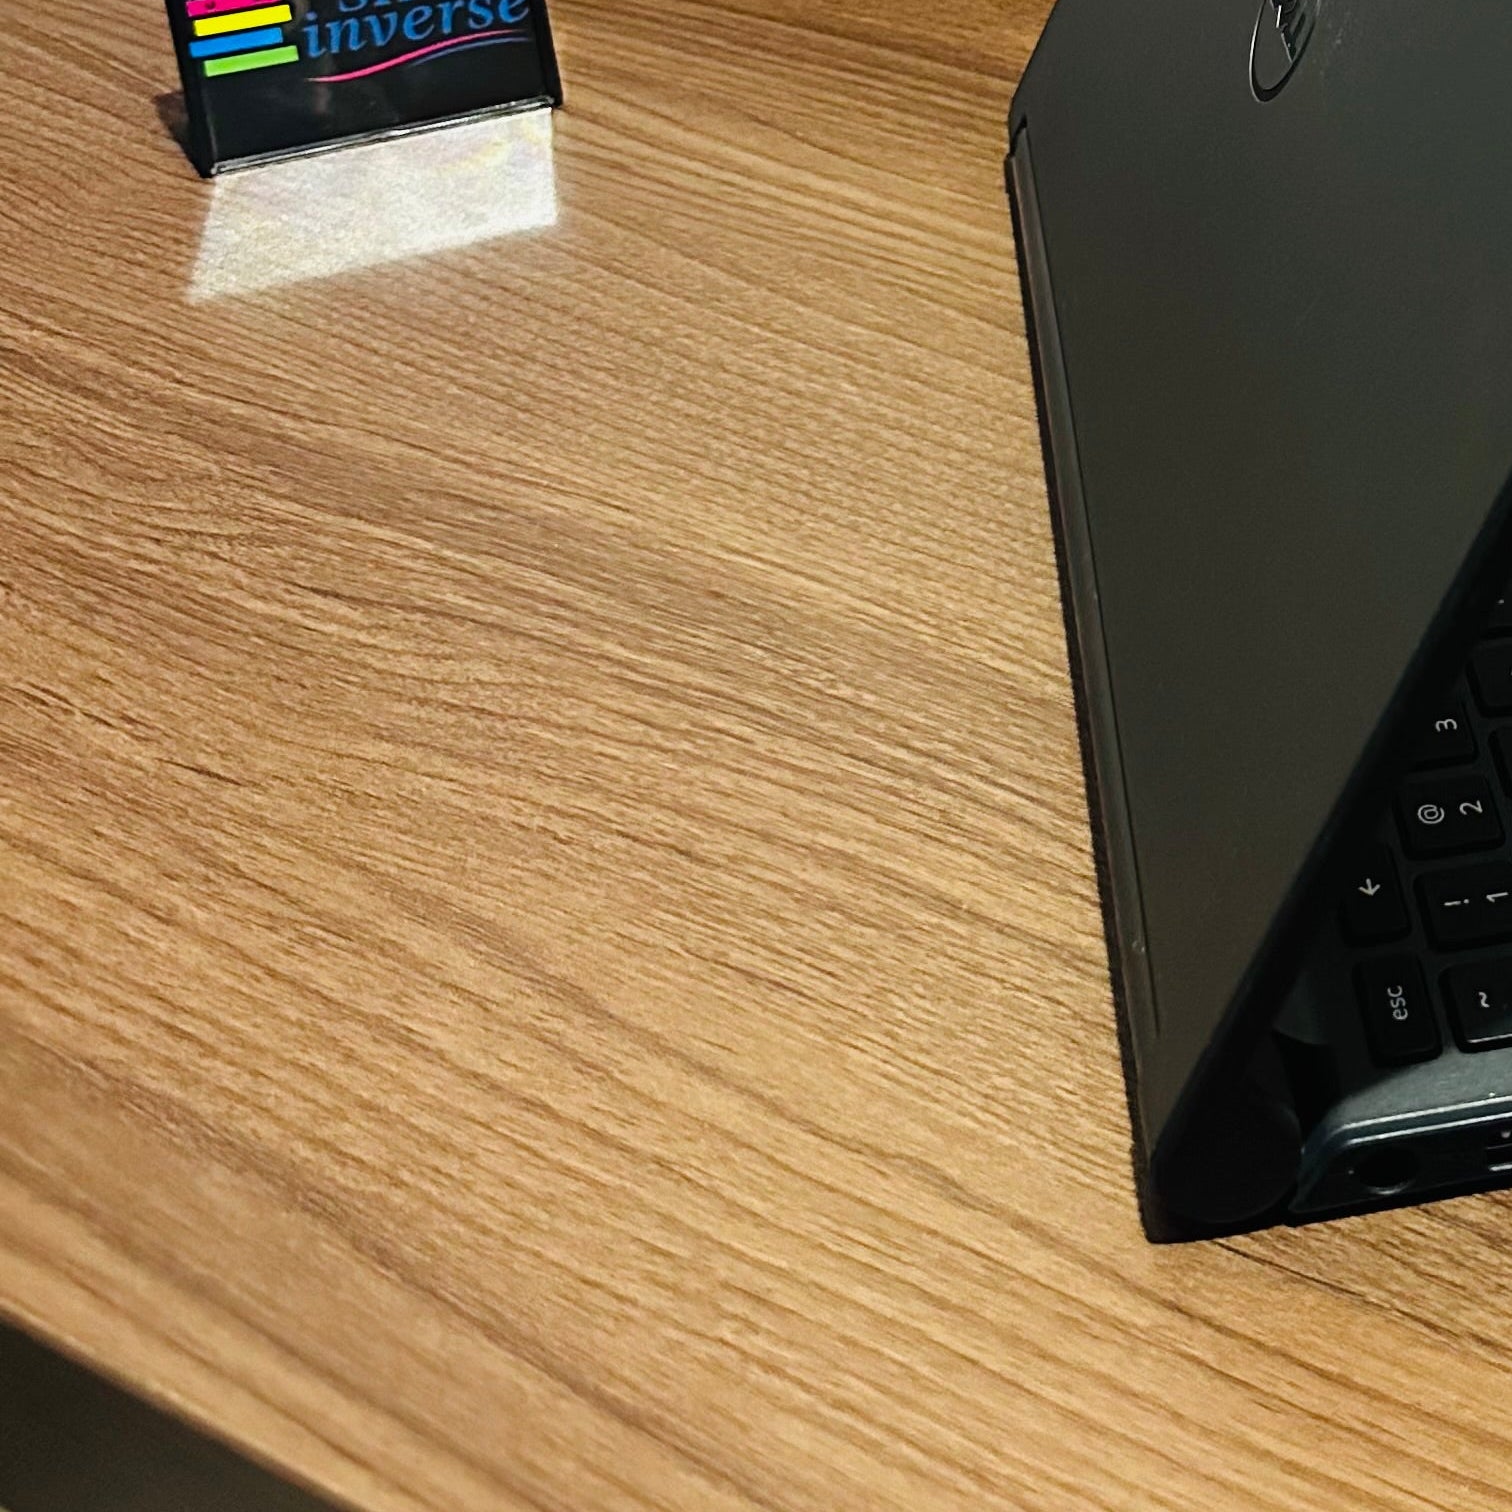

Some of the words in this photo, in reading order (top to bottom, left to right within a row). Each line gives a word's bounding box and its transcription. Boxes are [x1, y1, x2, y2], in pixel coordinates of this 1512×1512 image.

[1435, 718, 1458, 732] 3
[1417, 804, 1445, 825] @
[1459, 800, 1483, 815] 2
[1486, 891, 1509, 903] 1
[1387, 985, 1409, 1020] esc
